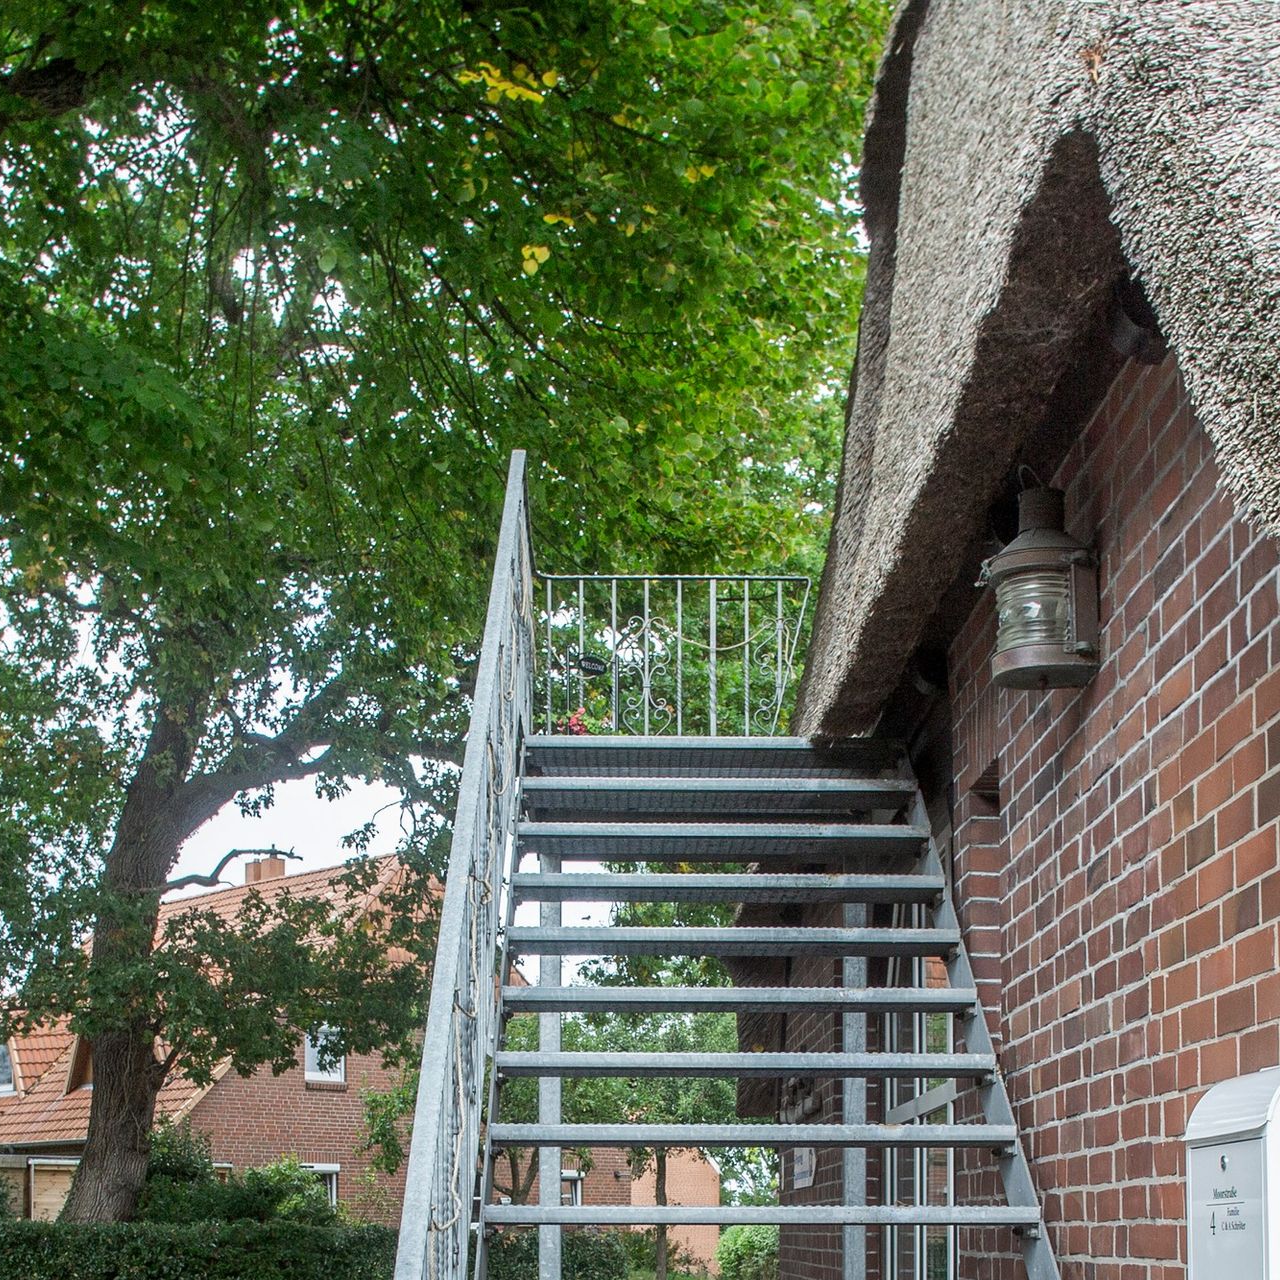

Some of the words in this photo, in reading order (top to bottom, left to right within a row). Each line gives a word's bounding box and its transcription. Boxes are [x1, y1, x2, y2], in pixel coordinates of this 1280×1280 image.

[581, 660, 605, 671] WELCOME
[1213, 1186, 1237, 1200] Moorstraße
[1210, 1211, 1216, 1235] 4
